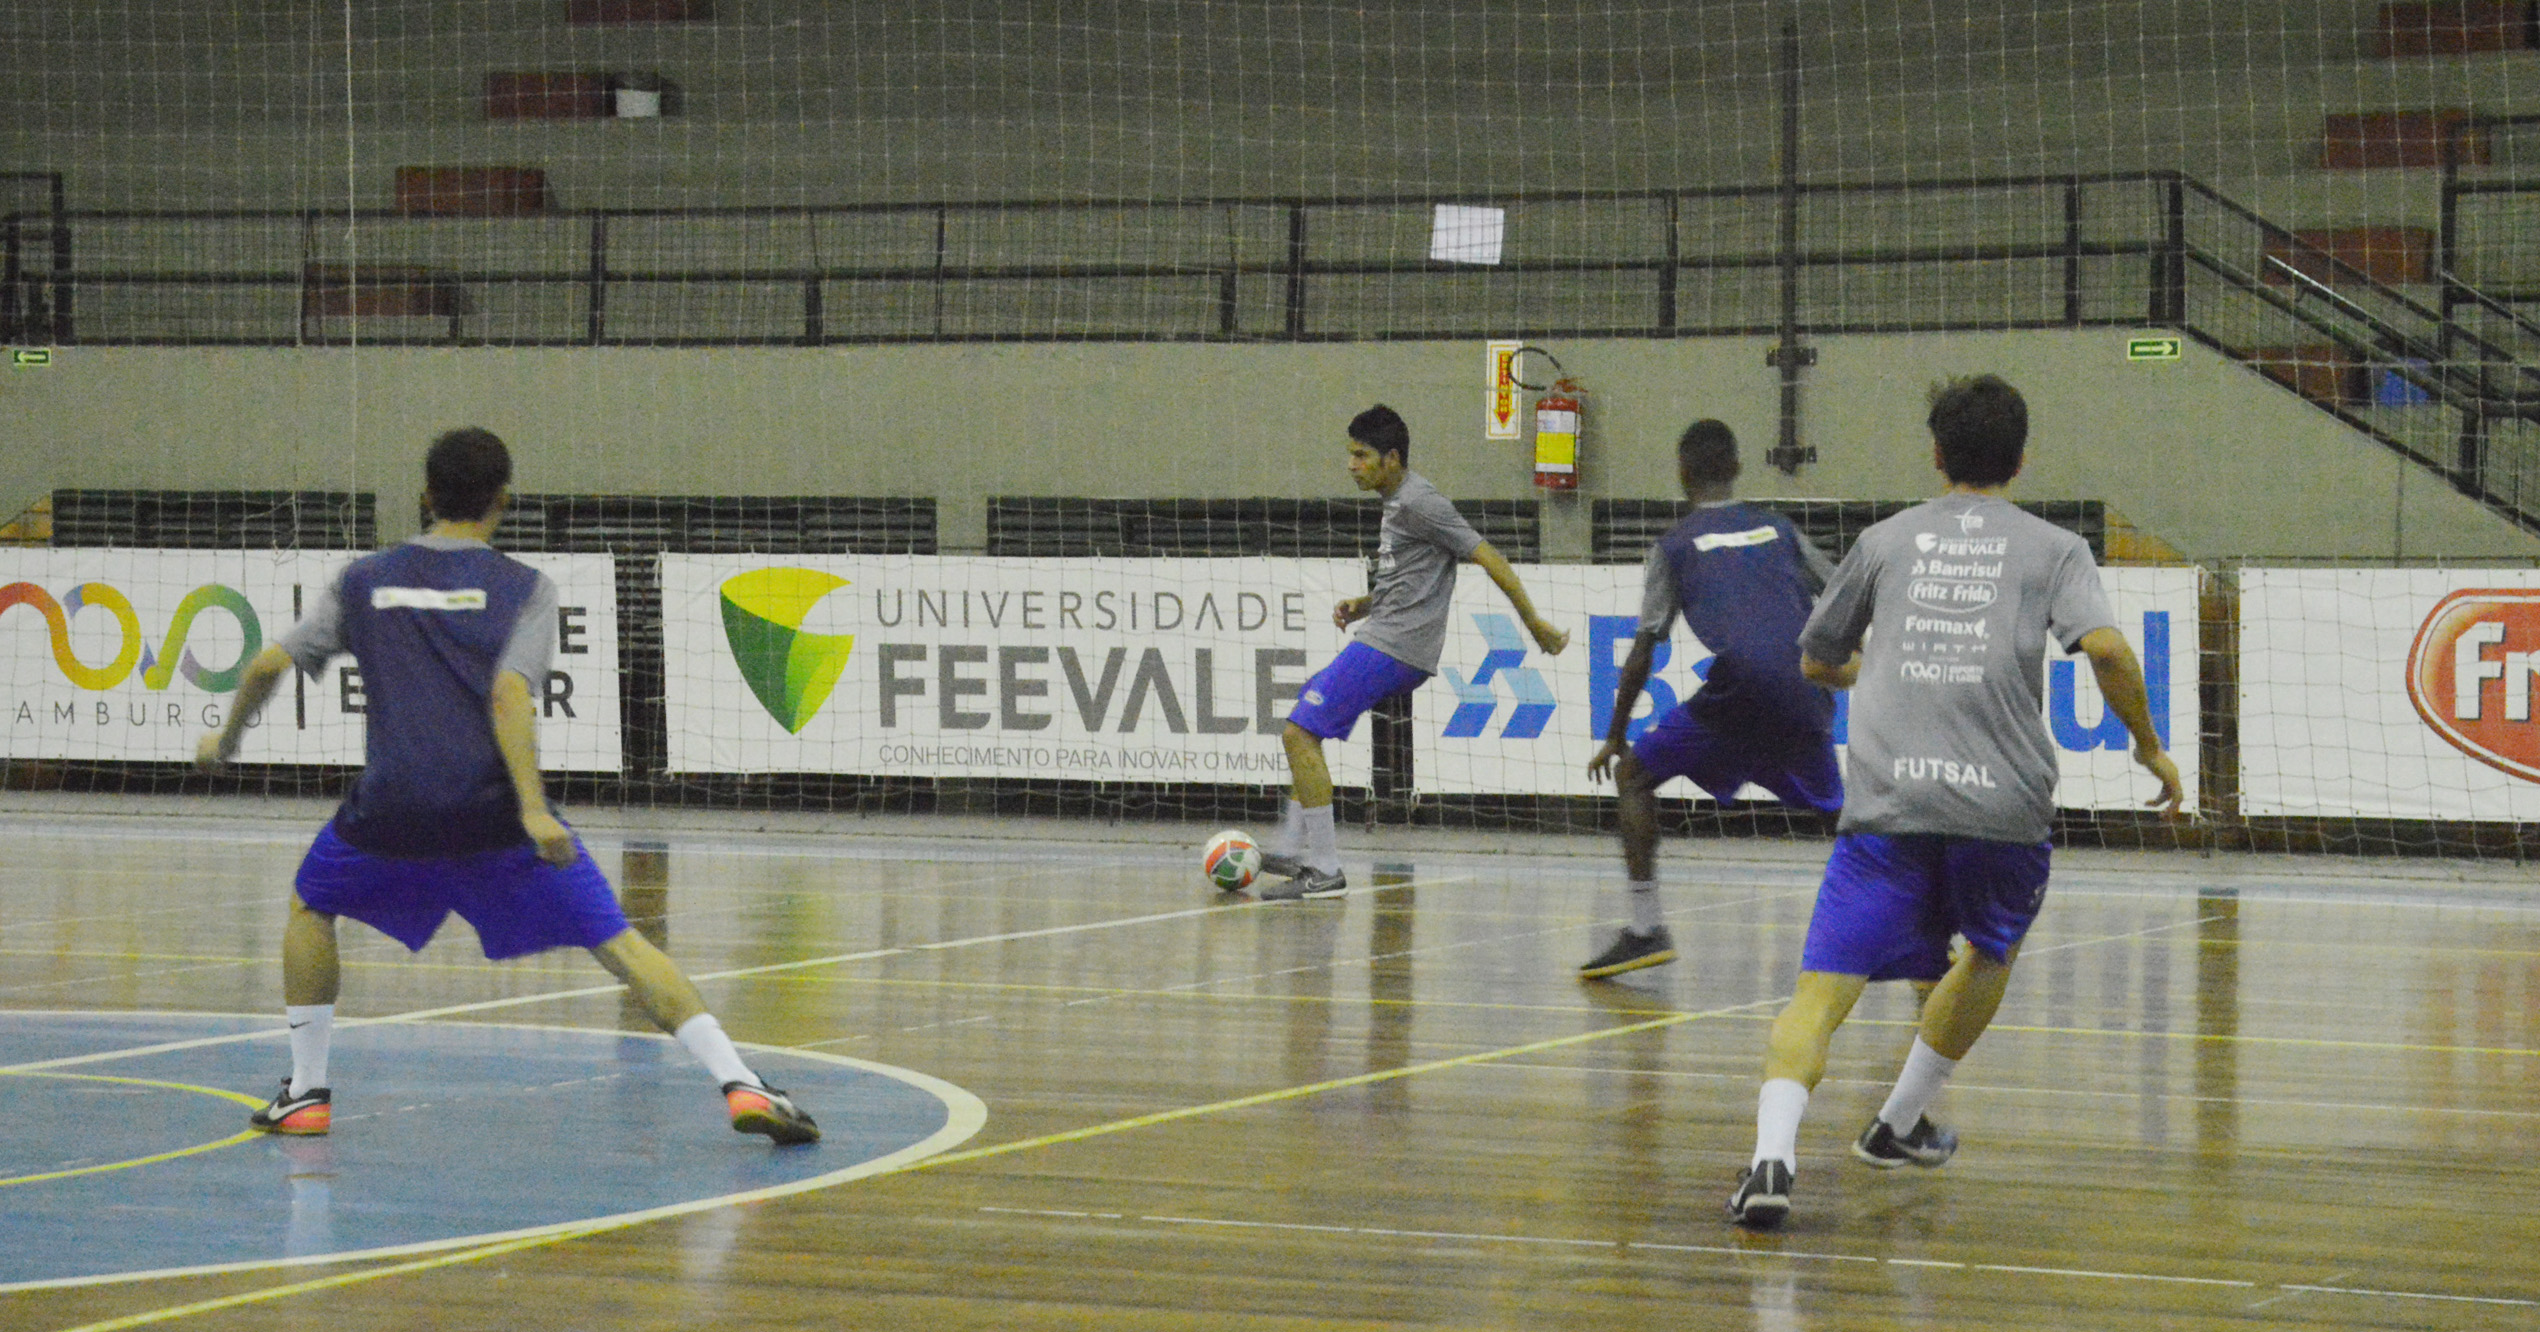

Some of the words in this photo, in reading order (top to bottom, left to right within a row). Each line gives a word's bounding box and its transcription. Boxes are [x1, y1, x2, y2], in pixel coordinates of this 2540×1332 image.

[1928, 559, 2003, 578] Banrisul
[1912, 582, 1949, 600] Fritz
[1952, 584, 1992, 603] Frida
[876, 588, 1306, 632] UNIVERSIDADE
[1905, 616, 1974, 635] Formax
[878, 643, 1307, 735] FEEVALE
[879, 744, 1050, 767] CONHECIMENTO
[1055, 748, 1113, 769] PARA
[1118, 750, 1197, 770] INOVAR
[1203, 751, 1220, 770] O
[1225, 752, 1291, 772] MUND
[1894, 757, 1996, 789] FUTSAL
